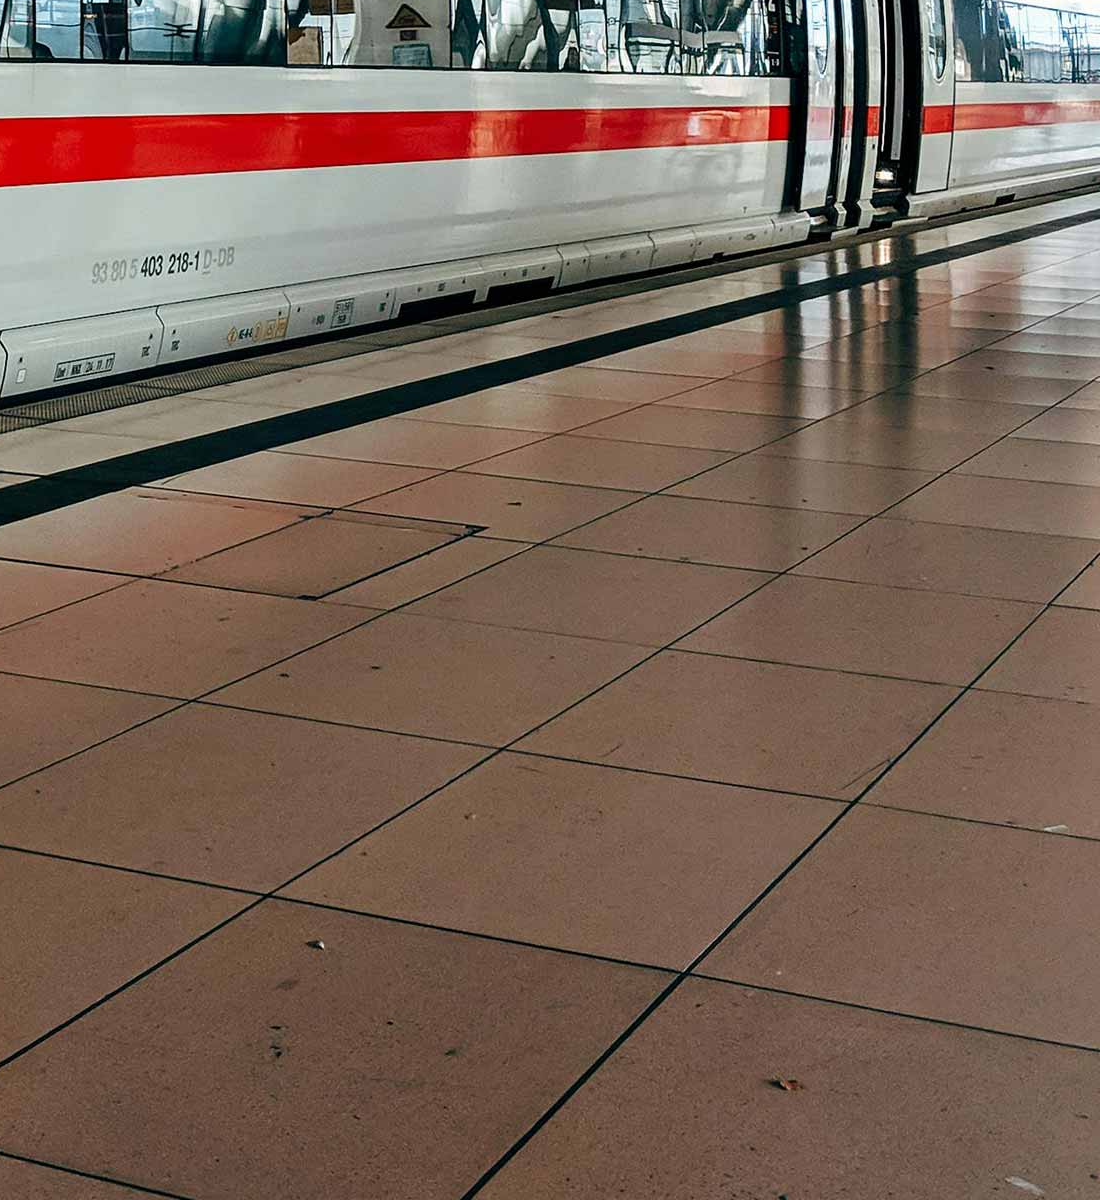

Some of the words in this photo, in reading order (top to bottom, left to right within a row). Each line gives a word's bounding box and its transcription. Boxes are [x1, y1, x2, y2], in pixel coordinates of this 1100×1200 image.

[92, 262, 108, 284] 93
[110, 259, 127, 282] 80
[129, 258, 139, 279] 5
[140, 255, 164, 277] 403
[167, 250, 200, 274] 218-1
[202, 247, 235, 275] D-DB
